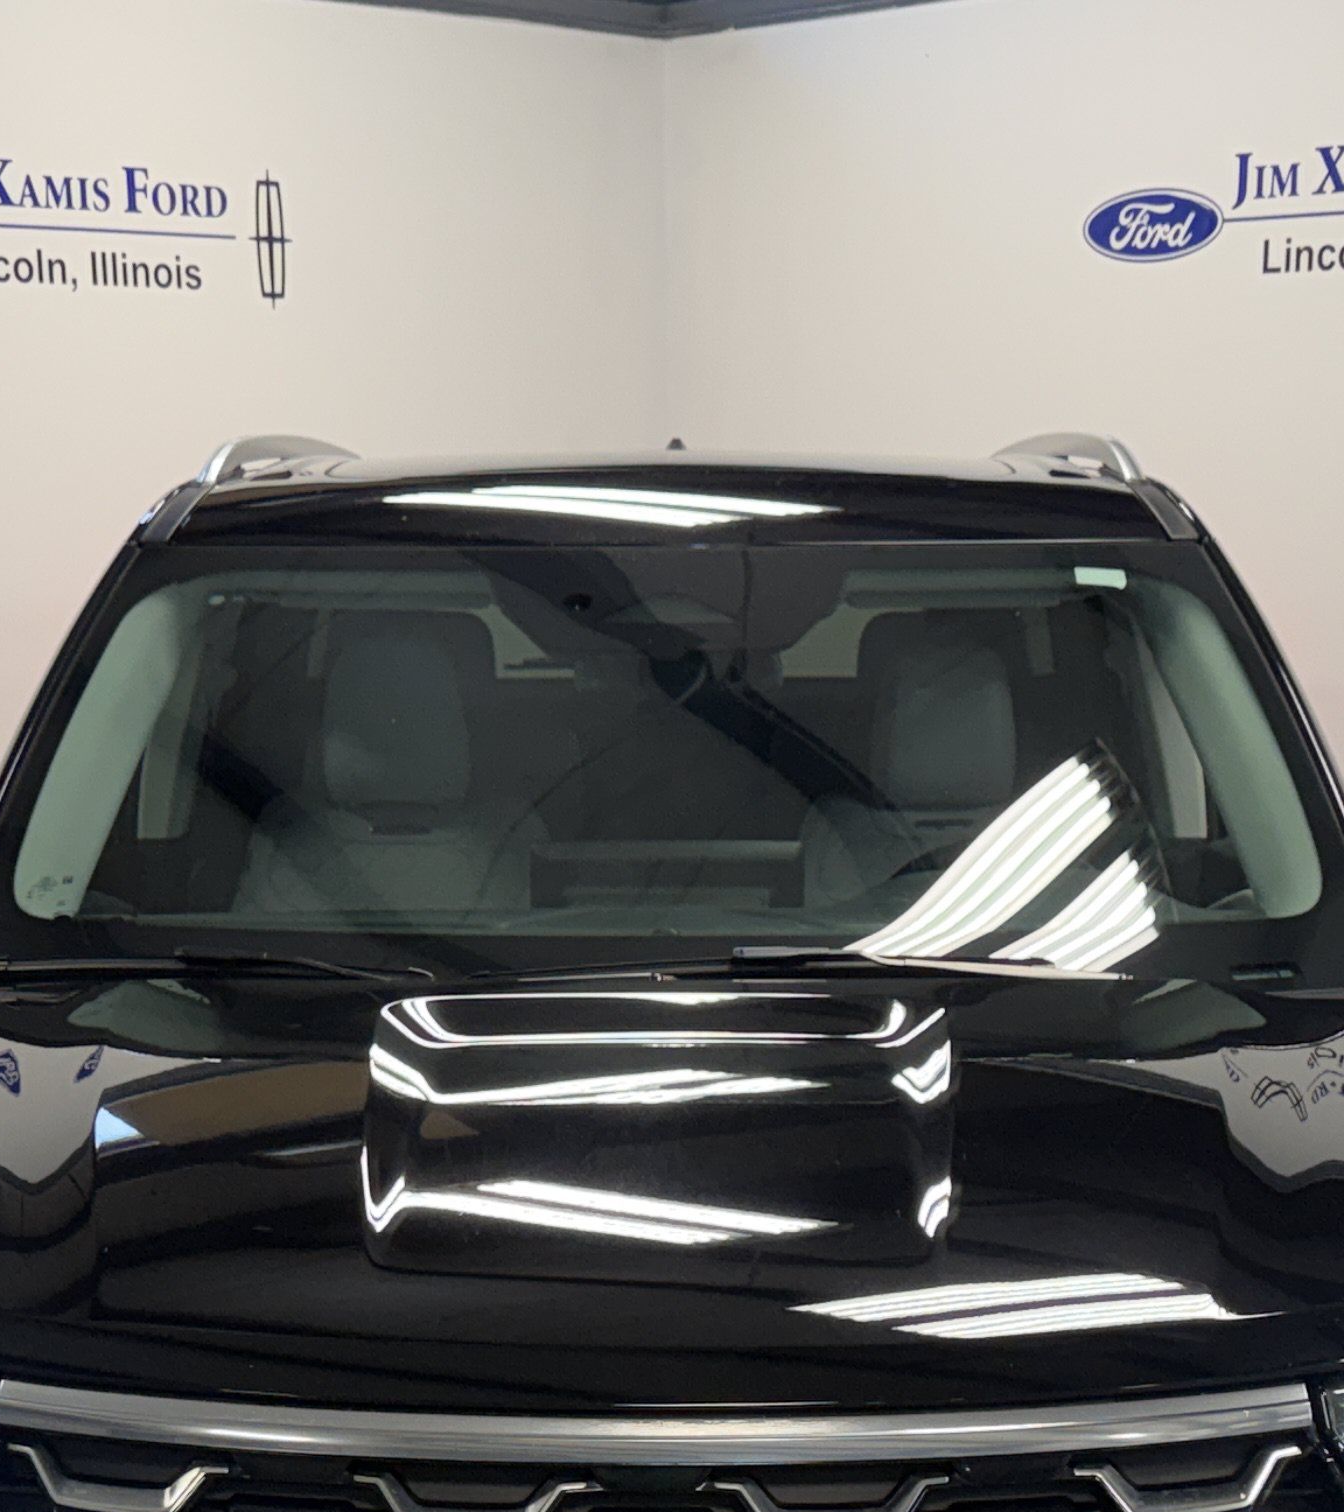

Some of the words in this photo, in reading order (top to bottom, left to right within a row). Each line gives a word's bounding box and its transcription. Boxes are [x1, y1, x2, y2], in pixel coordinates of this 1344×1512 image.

[123, 167, 227, 217] FORD
[1232, 153, 1299, 210] JIM
[1109, 202, 1196, 251] Ford
[91, 252, 201, 289] Illinois
